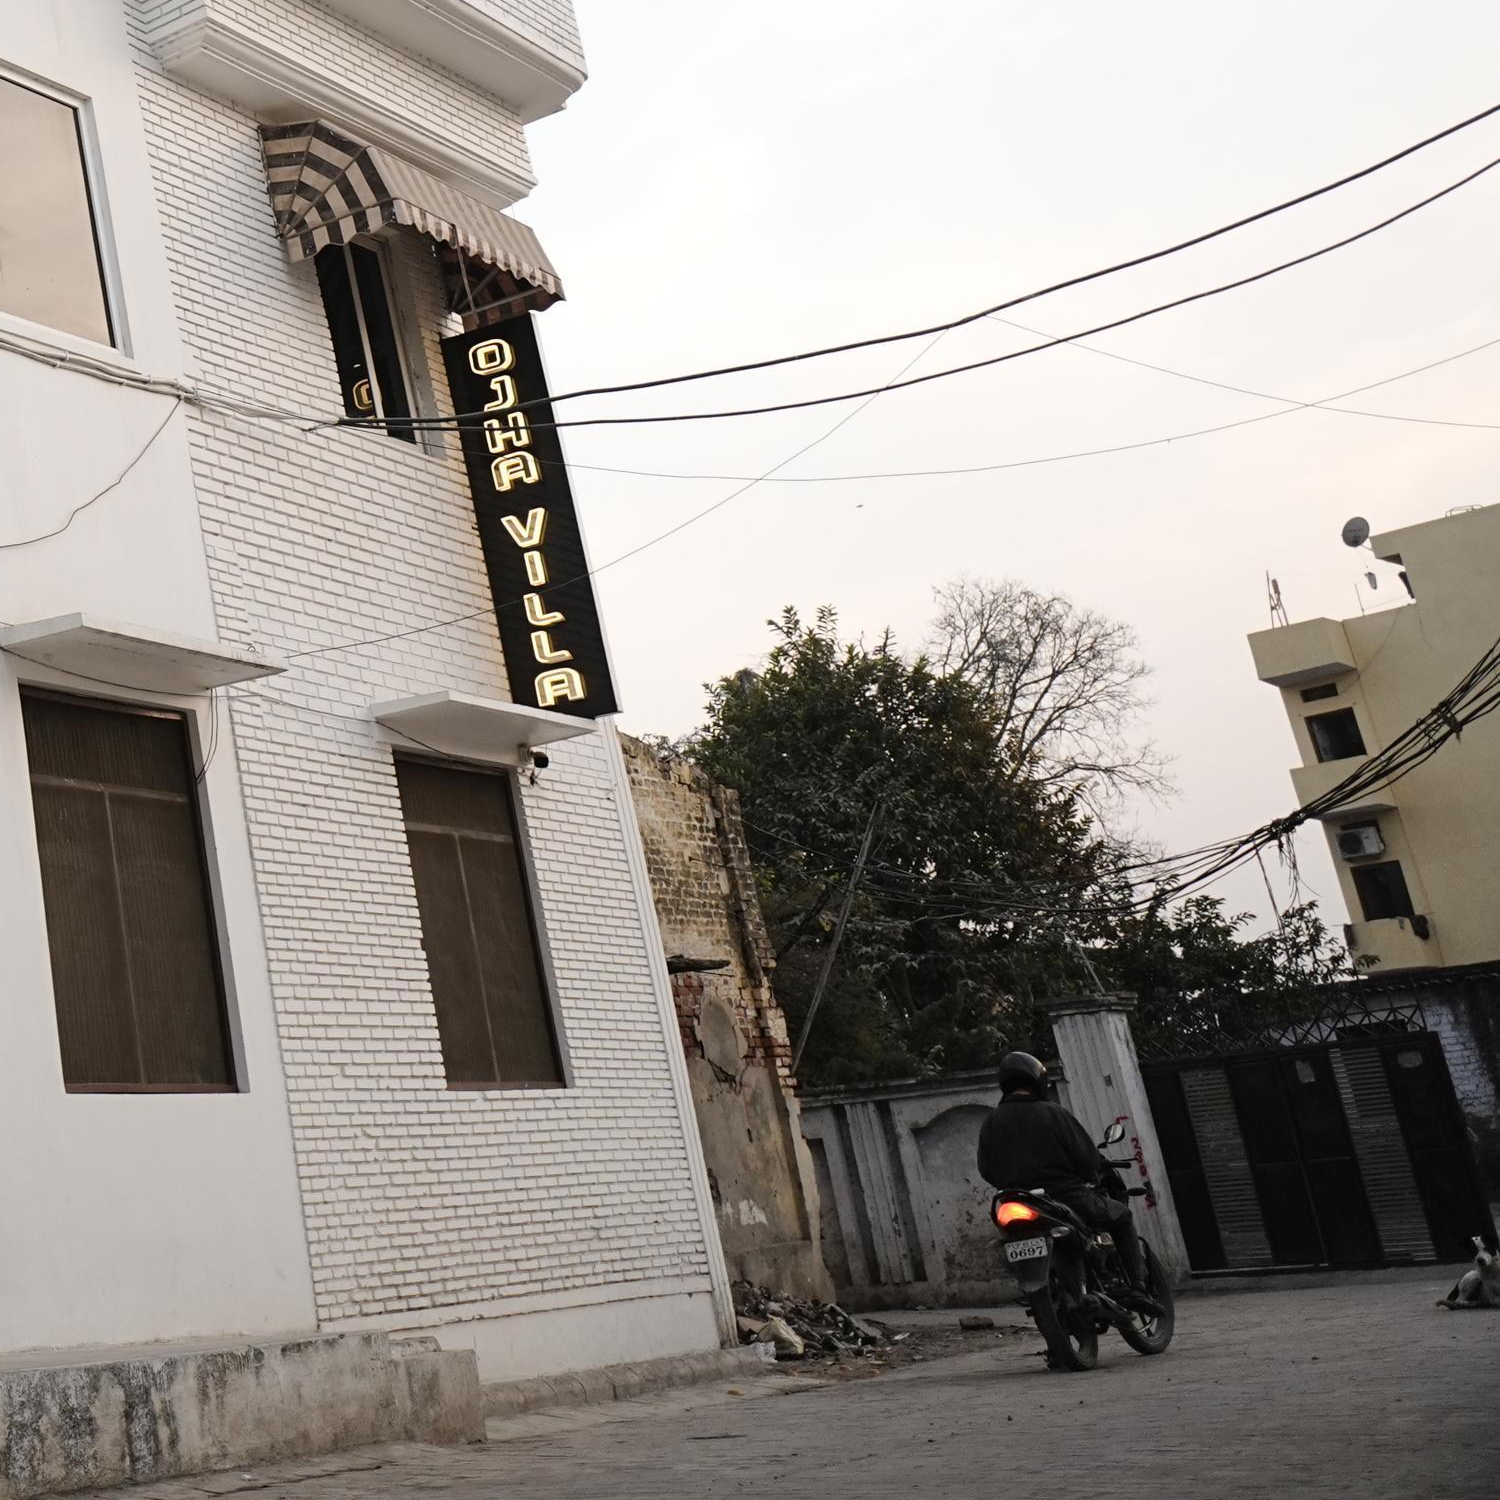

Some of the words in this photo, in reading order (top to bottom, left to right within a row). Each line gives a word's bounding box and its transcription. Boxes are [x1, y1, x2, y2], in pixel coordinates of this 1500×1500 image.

[468, 338, 542, 493] OJHA
[500, 507, 586, 708] VILLA
[1010, 1246, 1043, 1260] 0697
